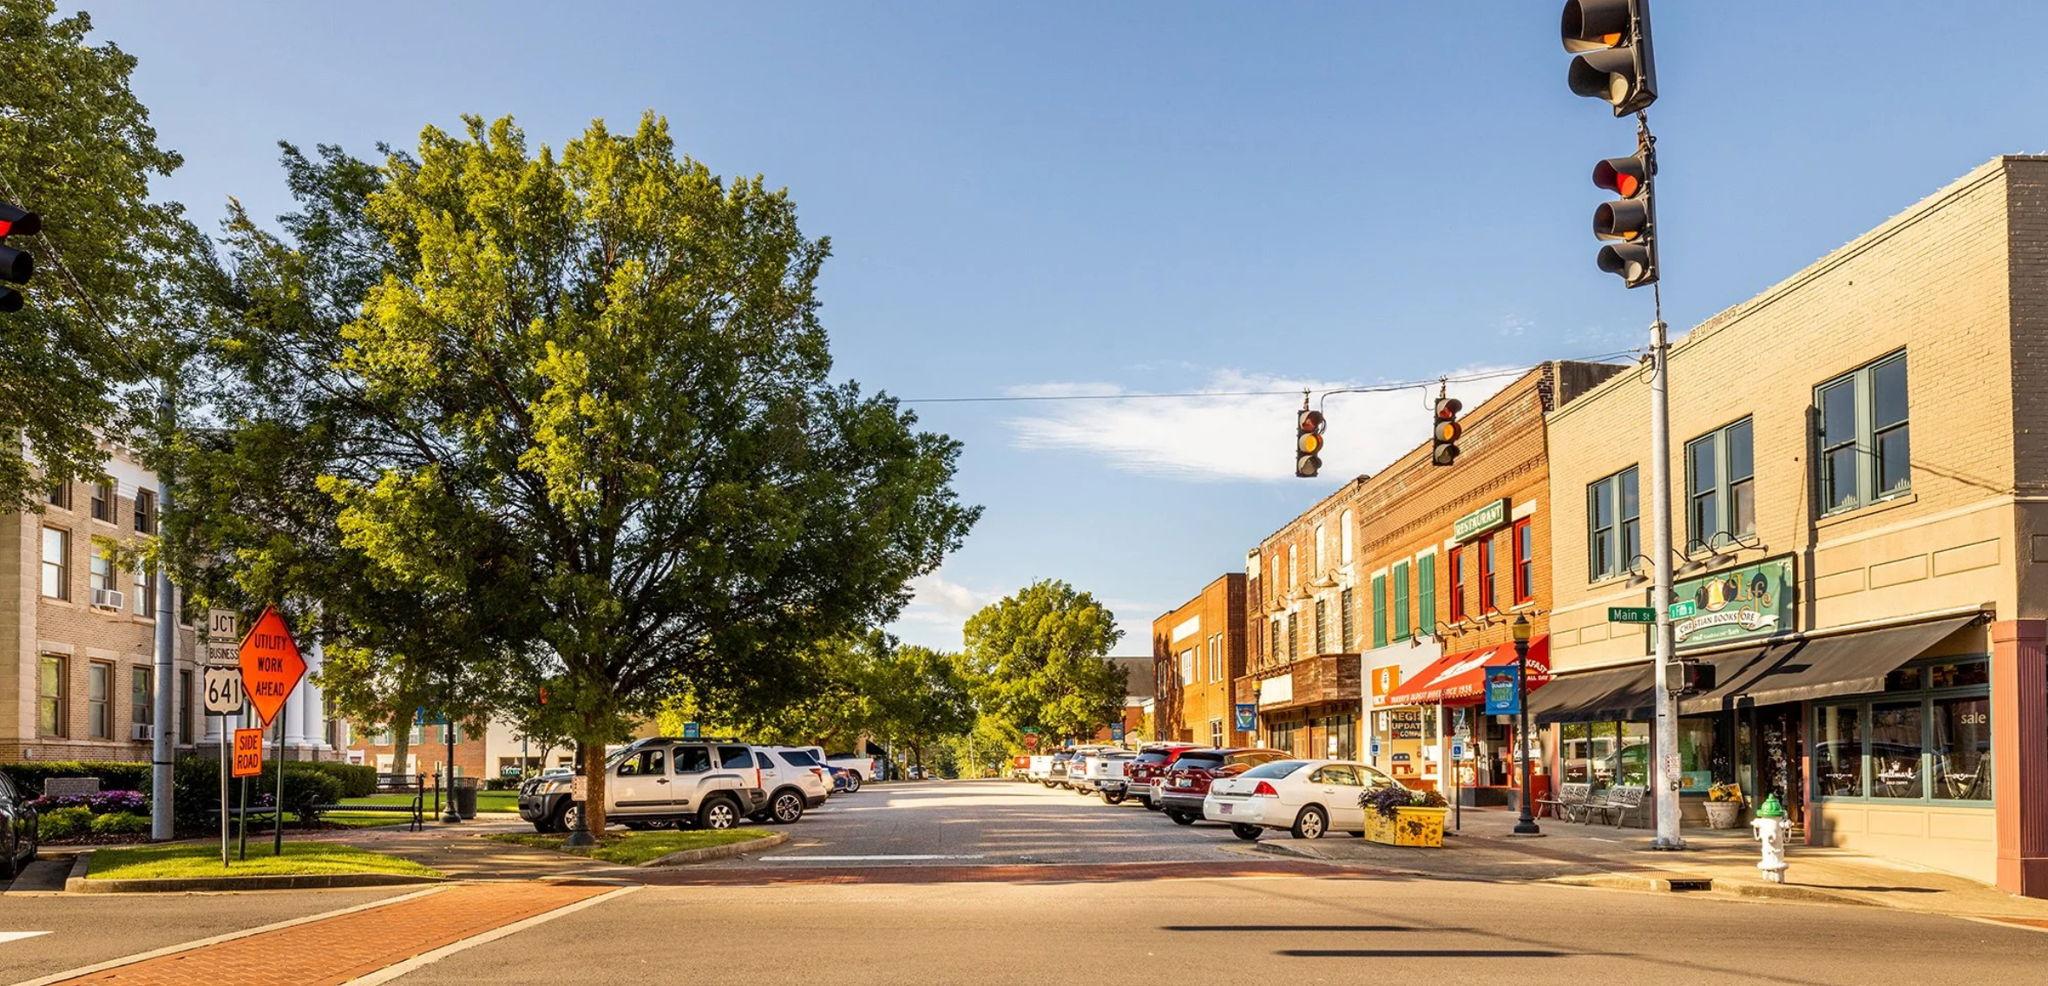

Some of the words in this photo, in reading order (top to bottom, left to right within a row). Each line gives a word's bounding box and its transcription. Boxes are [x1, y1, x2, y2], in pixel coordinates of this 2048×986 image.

[1456, 505, 1502, 536] RESTAURANT
[1733, 571, 1773, 612] Life
[1613, 608, 1638, 621] Main
[1713, 612, 1755, 623] BOOKSORE
[212, 615, 235, 633] JCT
[254, 633, 288, 650] UTILITY
[209, 647, 239, 660] BUSINESS
[257, 656, 284, 673] WORK
[209, 678, 239, 704] 641
[255, 683, 285, 697] AHEAD
[1961, 712, 1986, 724] sale
[239, 735, 258, 750] SIDE
[236, 754, 259, 770] ROAD
[1878, 767, 1916, 782] Hallmark
